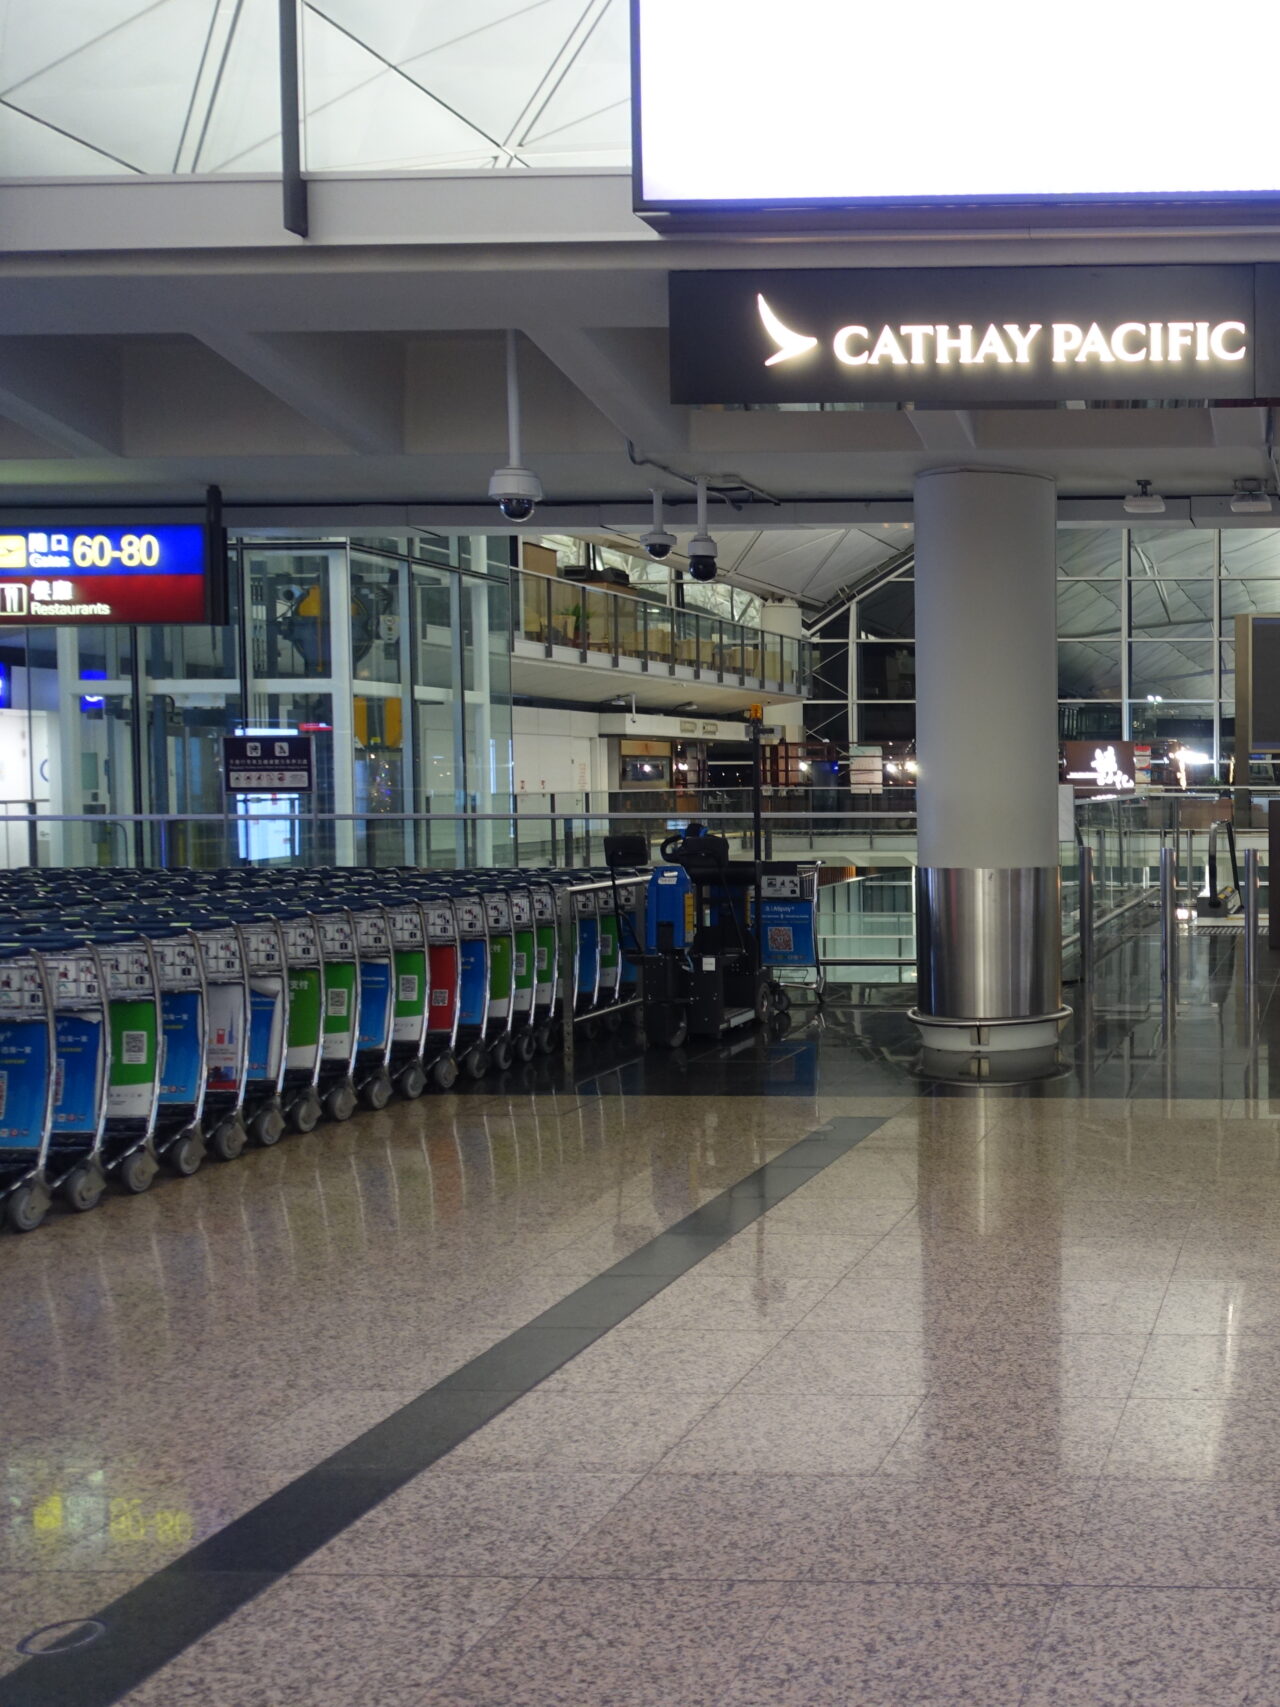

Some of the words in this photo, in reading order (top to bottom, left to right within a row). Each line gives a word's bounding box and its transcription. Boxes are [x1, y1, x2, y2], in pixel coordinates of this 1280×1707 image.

[833, 323, 1042, 366] CATHAY
[1052, 321, 1246, 364] PACIFIC
[73, 534, 160, 568] 60-80
[30, 601, 111, 616] Restaurants
